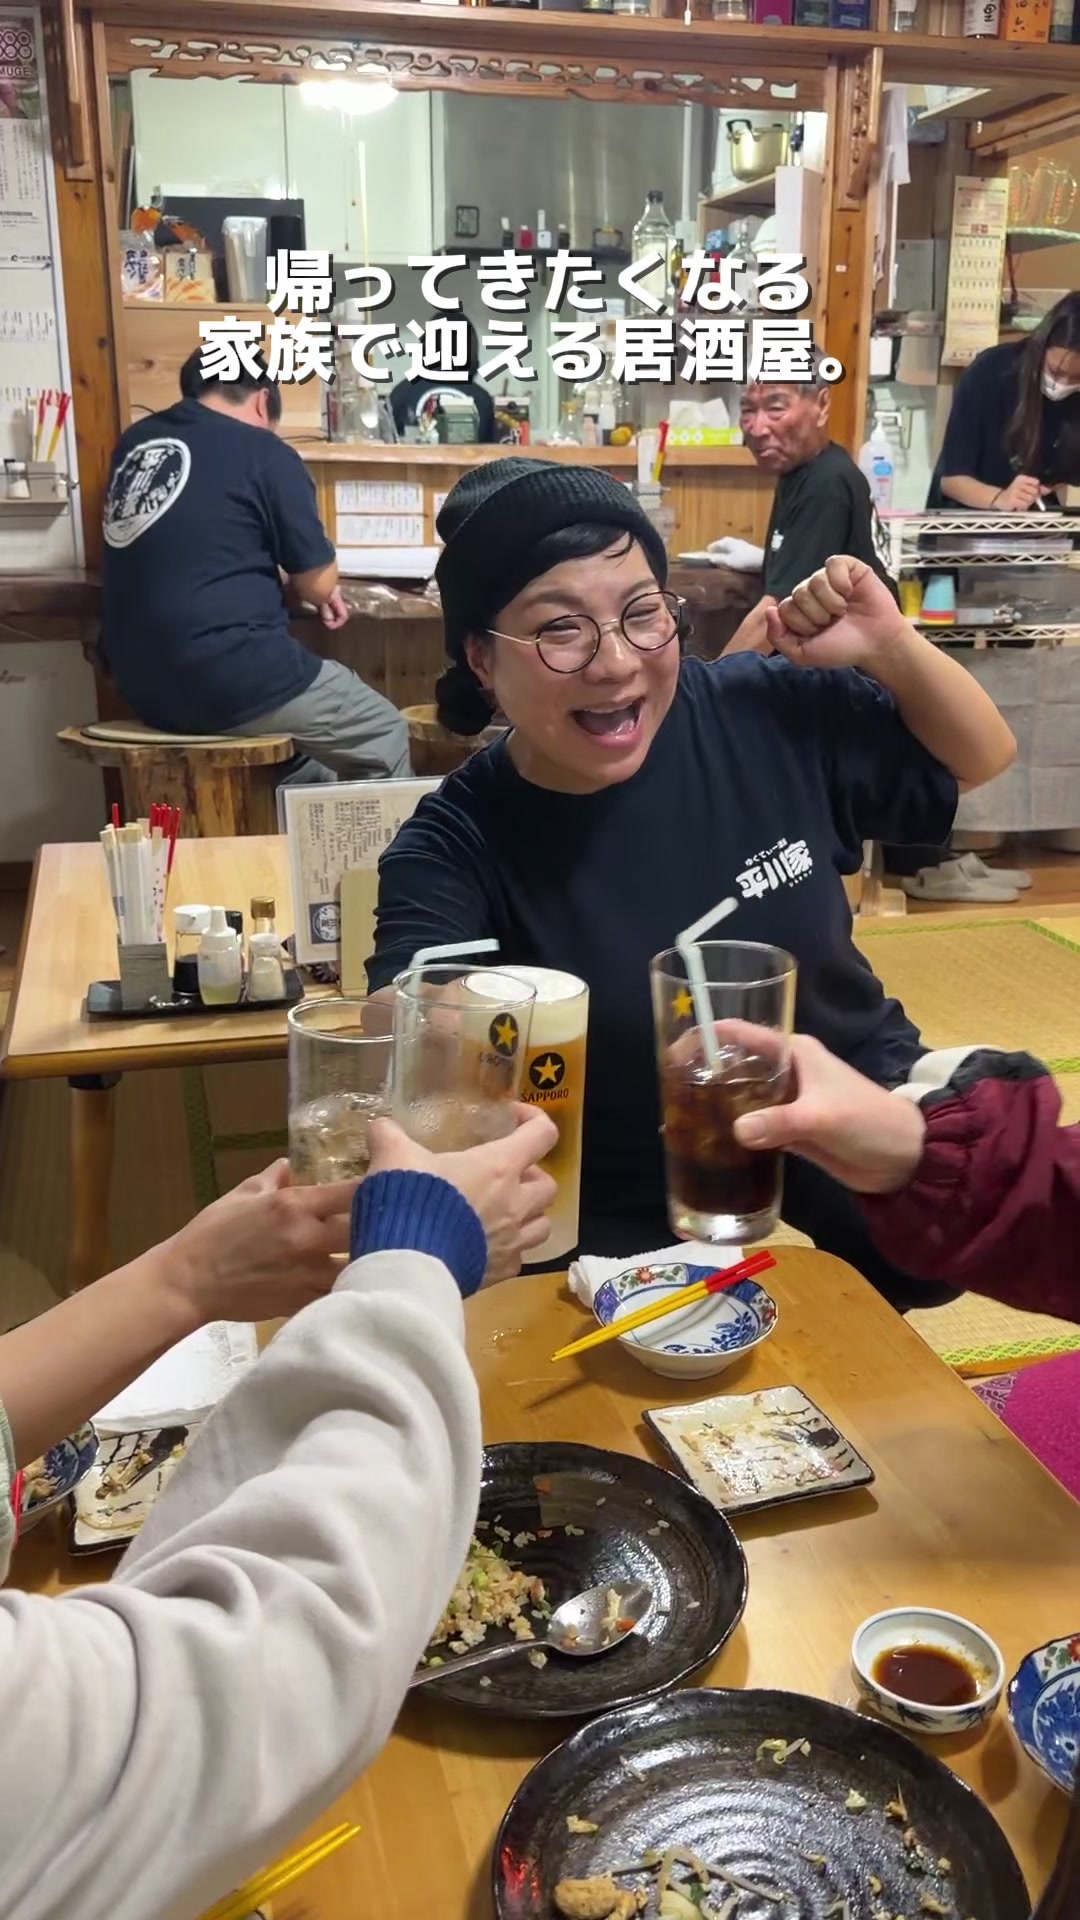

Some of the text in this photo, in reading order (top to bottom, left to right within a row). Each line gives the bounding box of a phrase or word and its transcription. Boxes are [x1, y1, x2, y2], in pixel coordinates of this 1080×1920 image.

[735, 840, 813, 899] 平川家
[520, 1088, 569, 1103] SAPPORO
